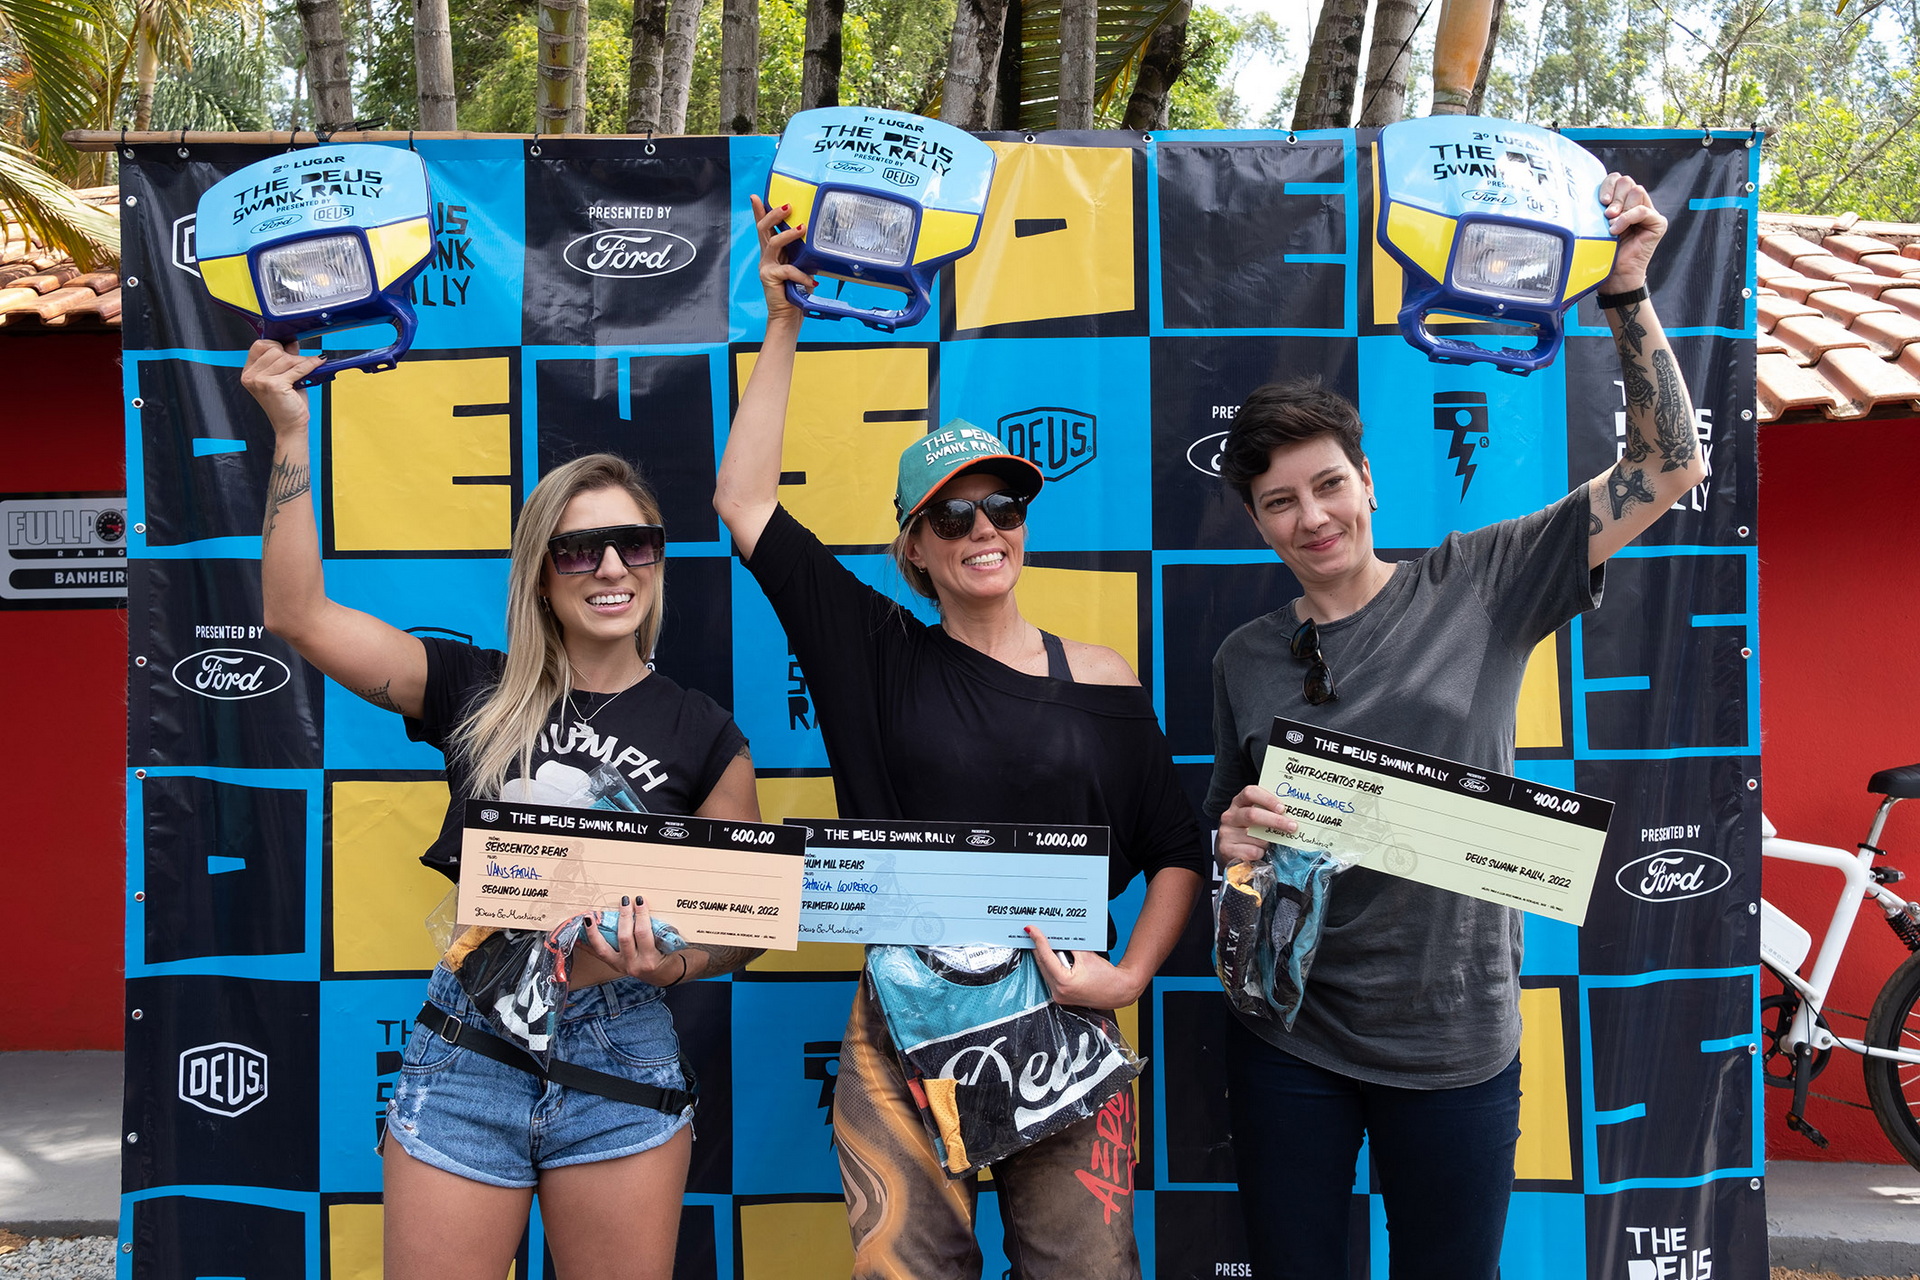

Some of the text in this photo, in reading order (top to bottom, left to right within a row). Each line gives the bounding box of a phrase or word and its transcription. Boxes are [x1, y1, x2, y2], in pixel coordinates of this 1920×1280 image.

[878, 117, 925, 134] LUGAR
[821, 125, 954, 164] THE DEUS
[1429, 143, 1495, 160] THE
[293, 155, 346, 169] LUGAR
[813, 139, 951, 177] SWANK RALLY
[854, 153, 905, 168] PRESENTED BY
[833, 161, 865, 173] Ford
[886, 169, 915, 185] DEUS
[233, 168, 384, 206] THE DEUS
[232, 184, 384, 226] SWANK RALLY
[1472, 191, 1508, 204] Ford
[276, 199, 319, 213] PRESENTED
[317, 207, 351, 221] DEUS
[589, 206, 672, 219] PRESENTED BY
[259, 216, 294, 232] Ford
[586, 234, 673, 270] Ford
[922, 428, 1000, 451] THE DEUS
[1007, 416, 1088, 470] DEUS
[925, 441, 969, 466] SWANK
[54, 571, 128, 584] BANHEIR
[195, 625, 264, 639] PRESENTED BY
[195, 655, 266, 691] Ford
[1314, 736, 1449, 782] THE DEUS SWANK RALLY
[1285, 761, 1384, 796] QUATROCENTOS REAIS
[1463, 778, 1486, 792] Ford
[1533, 791, 1581, 815] 400,00
[509, 811, 648, 835] THE DEUS SWANK RALLY
[1316, 813, 1343, 828] LUGAR
[663, 827, 685, 838] Ford
[731, 829, 775, 845] 600,00
[824, 828, 849, 840] THE
[853, 829, 886, 842] DEUS
[889, 831, 923, 843] SWANK
[925, 832, 956, 844] RALLY
[970, 835, 991, 846] Ford
[1036, 832, 1088, 848] 1.000,00
[1641, 824, 1701, 842] PRESENTED BY
[485, 841, 569, 857] SEISCENTOS REAIS
[804, 859, 865, 870] HUM MIL REAIS
[1465, 852, 1572, 889] DEUS SWANK RALLY, 2022
[1640, 857, 1705, 895] Ford
[481, 884, 549, 898] SEGUNDO LUGAR
[676, 898, 779, 916] DEUS SWANK RALLY, 2022
[801, 901, 866, 911] PRIMEIRO LUGAR
[987, 905, 1087, 918] DEUS SWANK RALLY, 2022
[189, 1051, 261, 1106] DEUS
[1625, 1226, 1688, 1254] THE
